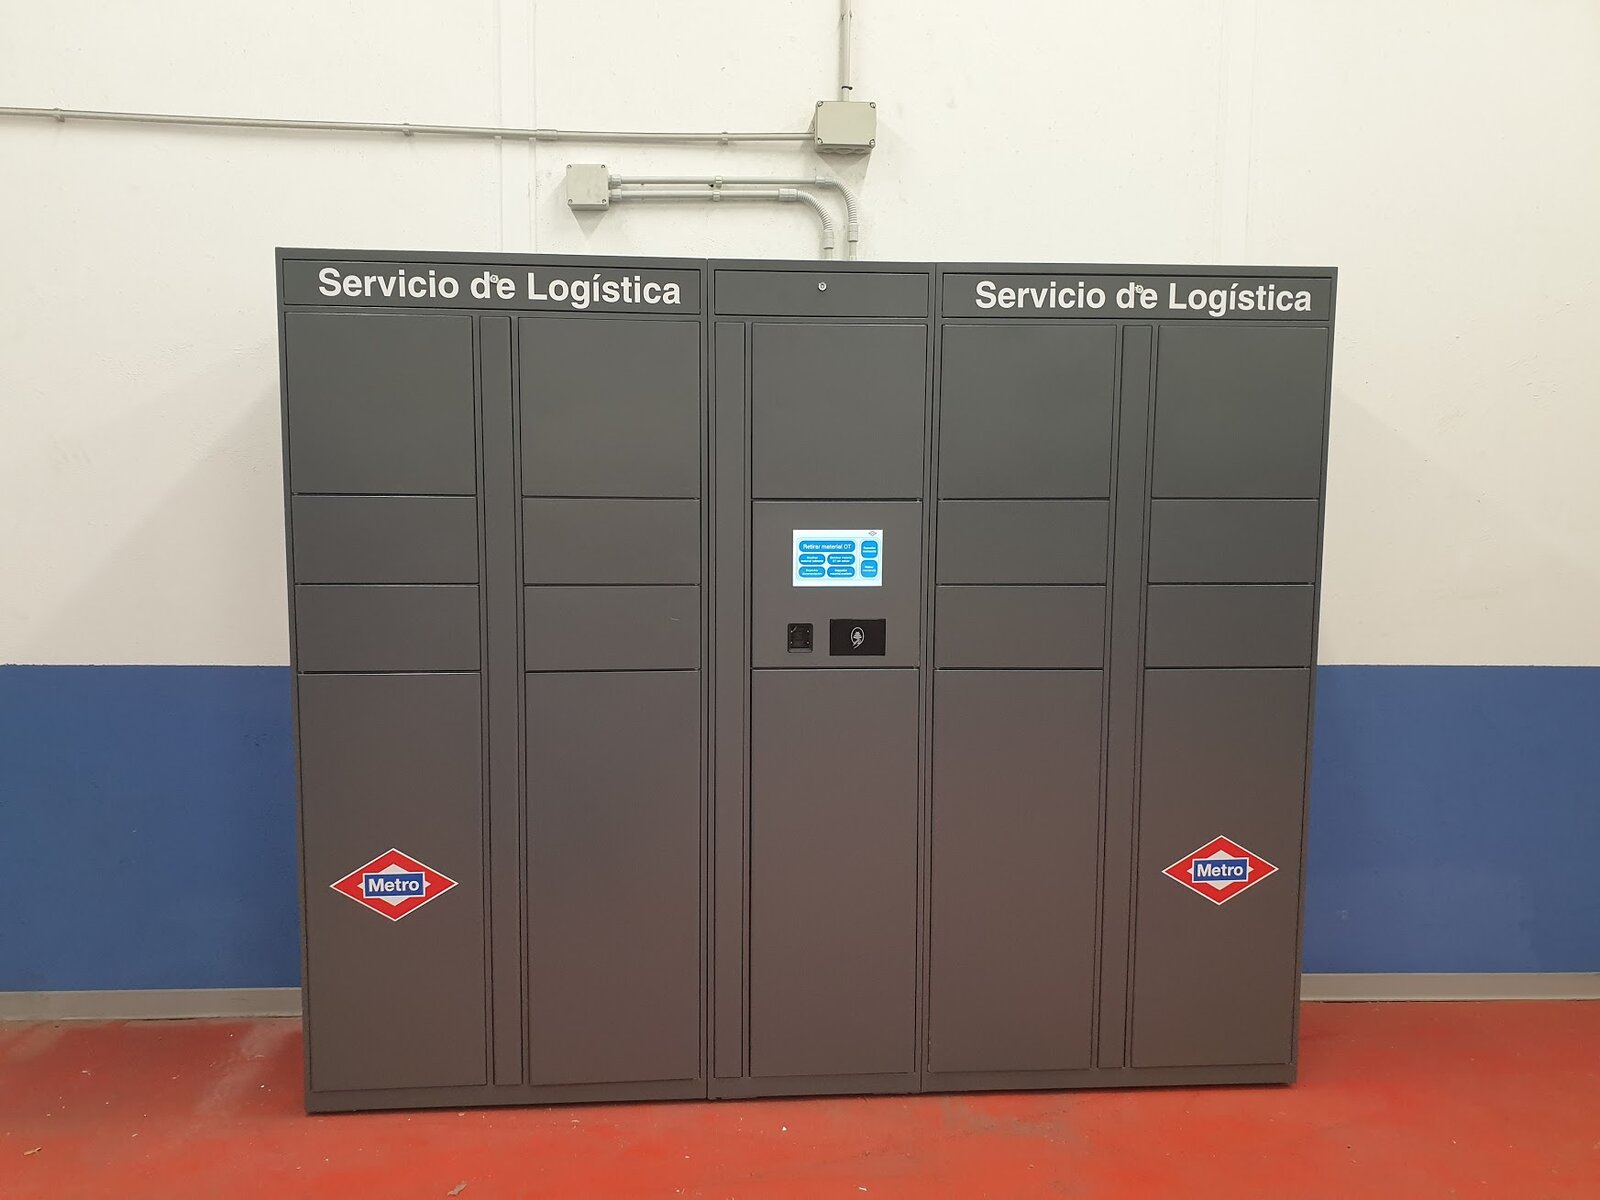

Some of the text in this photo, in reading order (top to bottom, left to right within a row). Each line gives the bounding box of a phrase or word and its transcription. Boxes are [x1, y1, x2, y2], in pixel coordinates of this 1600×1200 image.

[319, 268, 680, 309] Servicio de Logística
[976, 281, 1311, 317] Servicio de Logística
[1197, 863, 1244, 877] Metro
[368, 878, 420, 892] Metro
